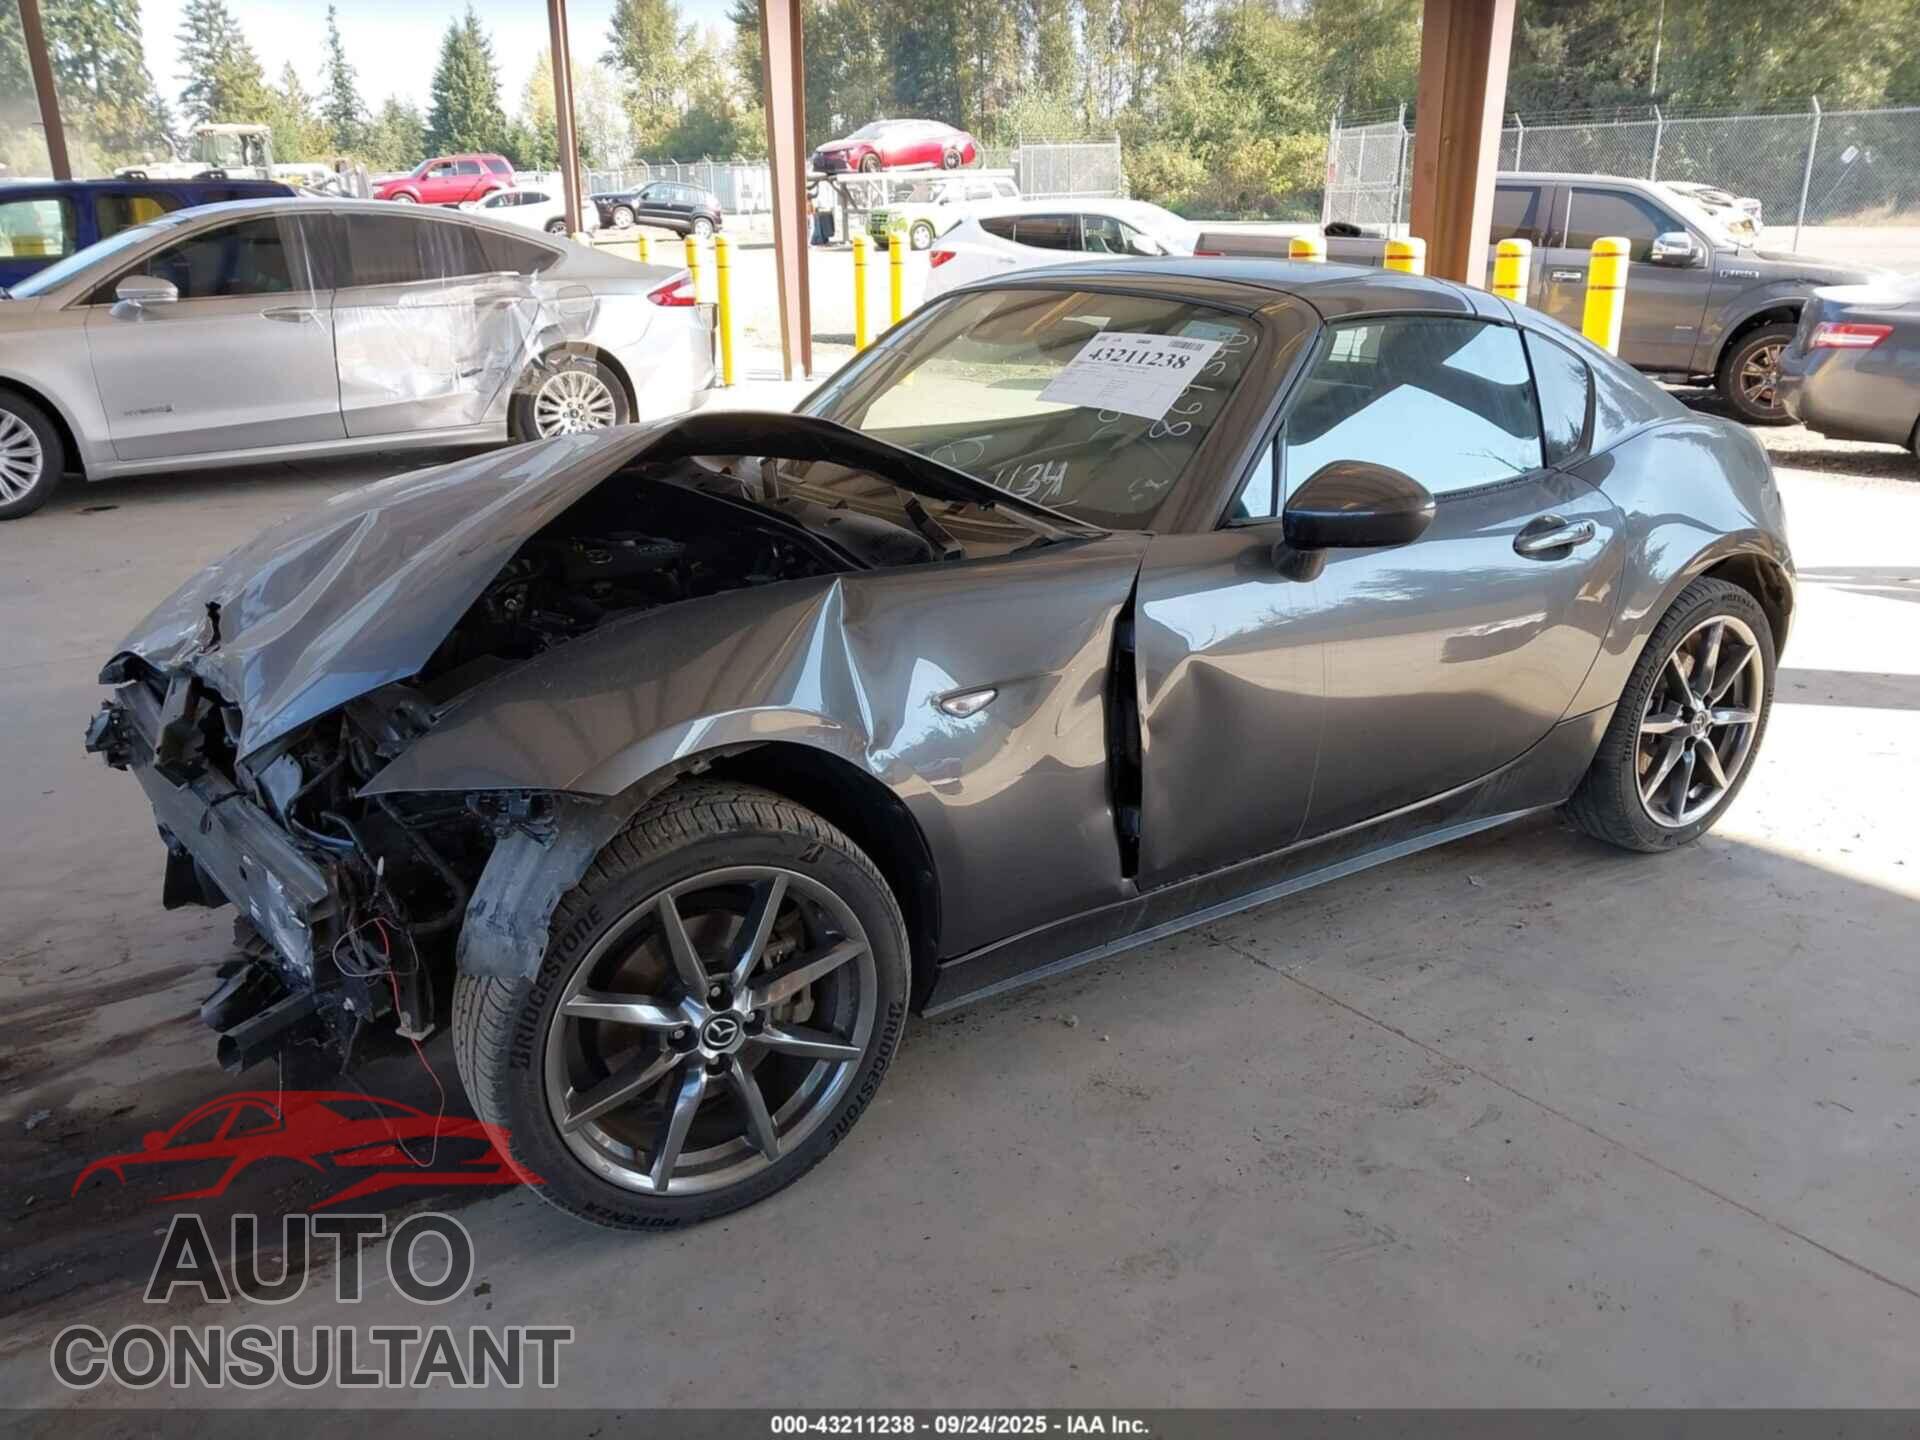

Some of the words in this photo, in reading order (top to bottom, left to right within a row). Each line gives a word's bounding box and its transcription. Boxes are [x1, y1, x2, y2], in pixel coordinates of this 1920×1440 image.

[1089, 347, 1190, 369] 43211238
[509, 903, 603, 1070] BRIDGESTONE
[827, 1001, 903, 1146] BRIDGESTONE
